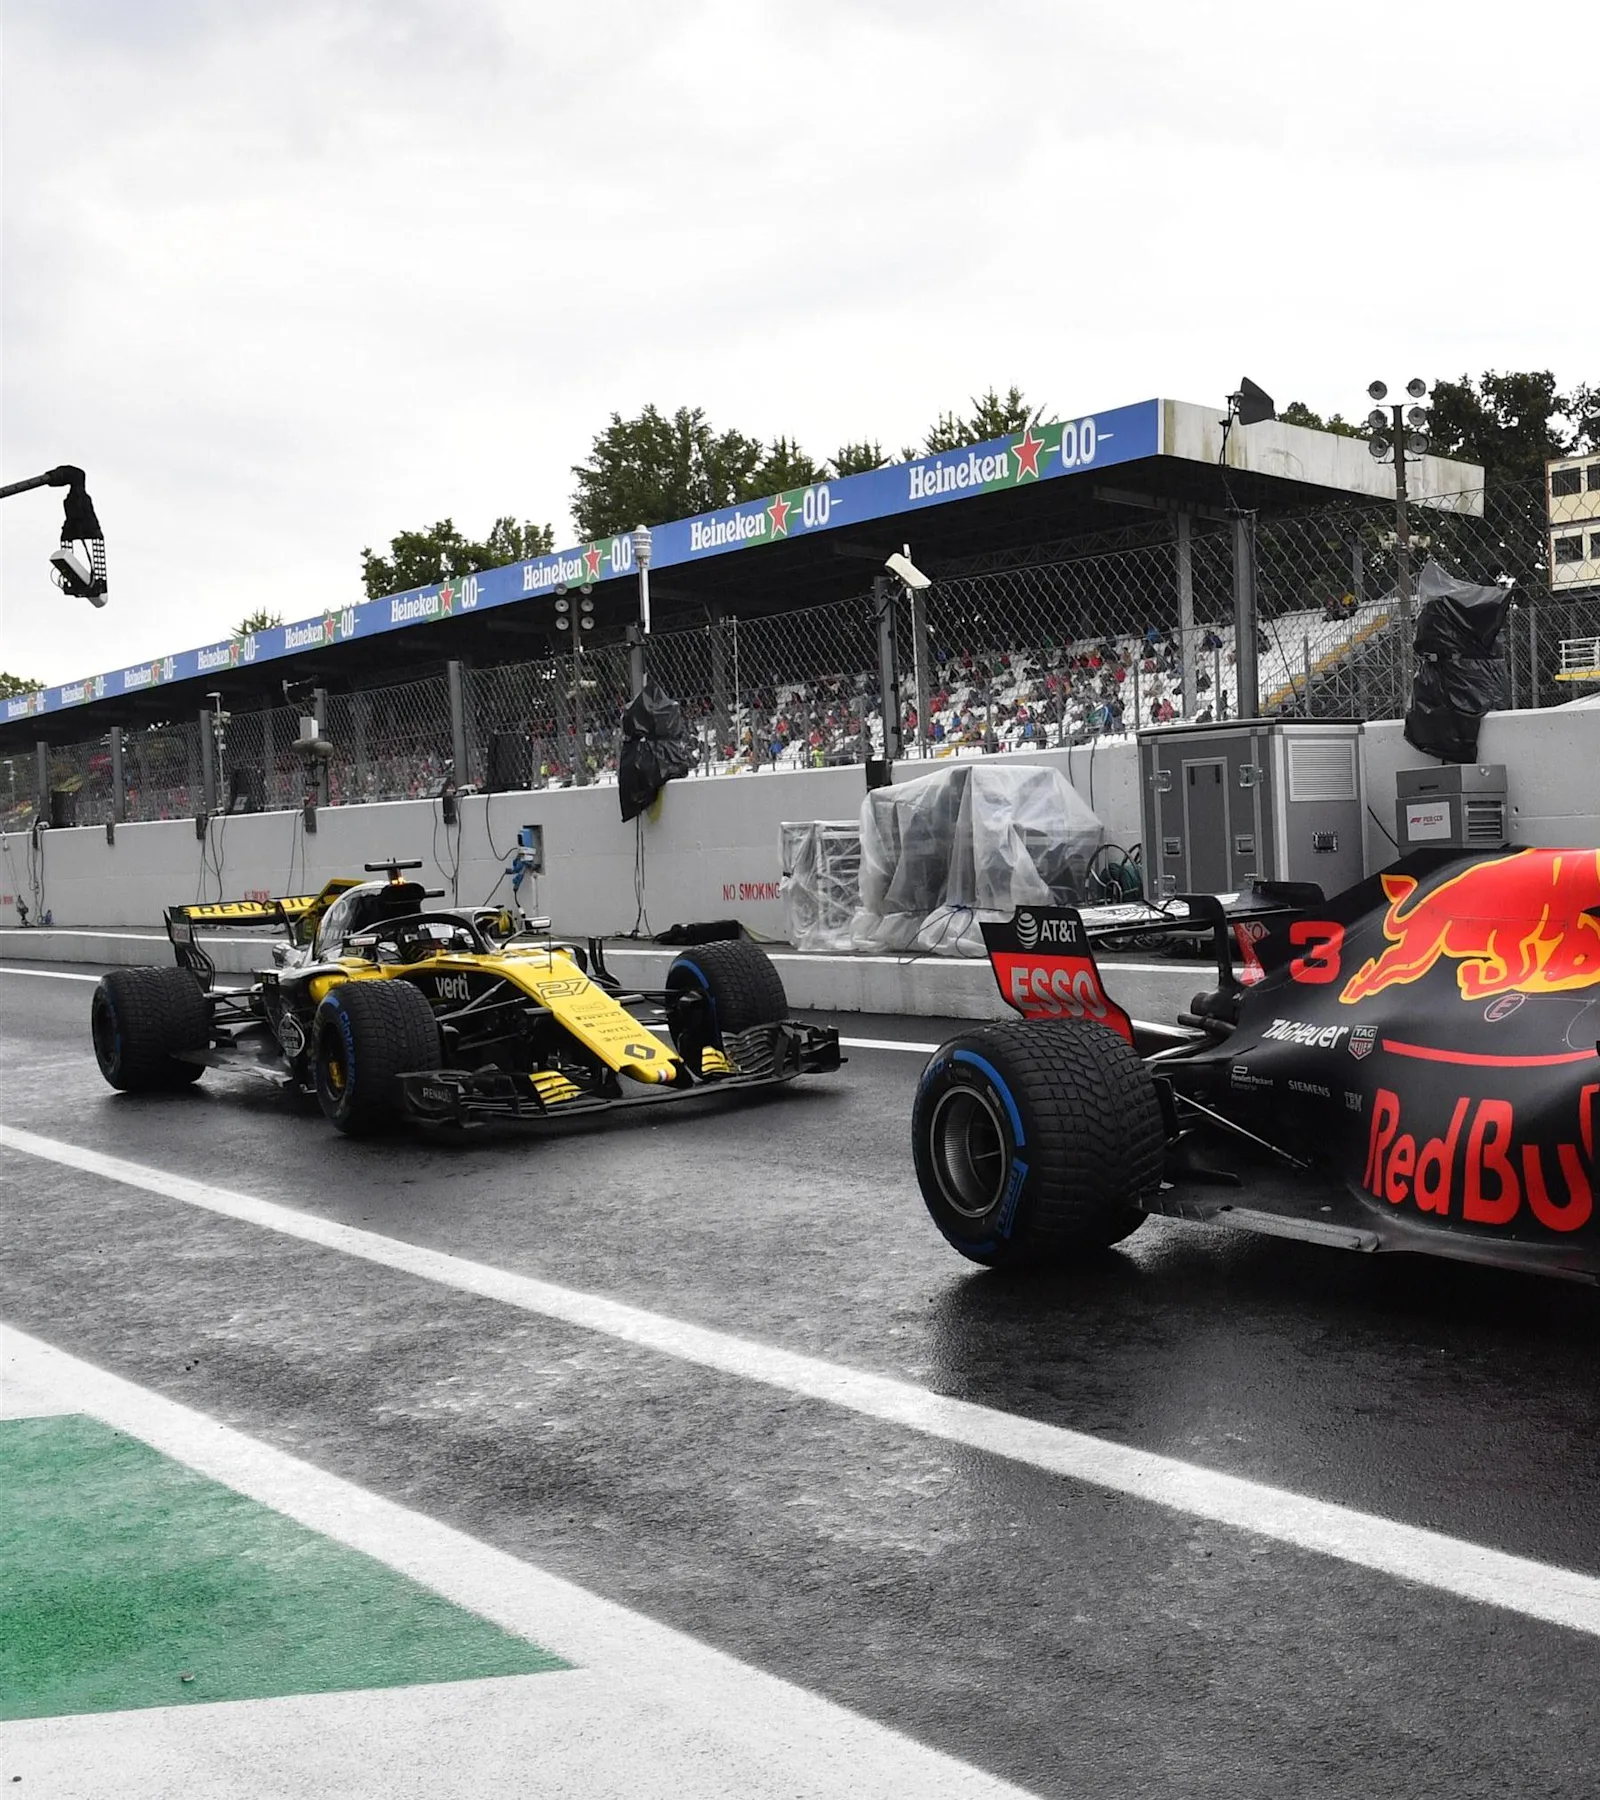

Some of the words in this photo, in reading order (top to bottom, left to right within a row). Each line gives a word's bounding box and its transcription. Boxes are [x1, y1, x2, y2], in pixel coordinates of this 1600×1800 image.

[909, 452, 1010, 500] Heineken
[1062, 417, 1096, 469] 0.0
[690, 510, 766, 551] Heineken
[803, 485, 830, 525] 0.0
[523, 556, 582, 592] Heineken
[612, 535, 631, 573] 0.0
[391, 594, 439, 623] Heineken
[461, 576, 478, 609] 0.0
[285, 623, 323, 649] Heineken
[198, 646, 229, 670] Heineken
[723, 884, 736, 901] NO
[739, 882, 781, 901] SMOKING
[1040, 918, 1078, 943] AT&T
[1289, 920, 1346, 984] 3
[435, 973, 471, 1000] verti
[536, 977, 591, 999] 27
[1010, 966, 1107, 1017] ESSO
[1355, 1028, 1375, 1038] TAG
[1350, 1040, 1373, 1056] HEUER
[1288, 1080, 1331, 1098] SIEMENS
[1344, 1091, 1363, 1111] IBM
